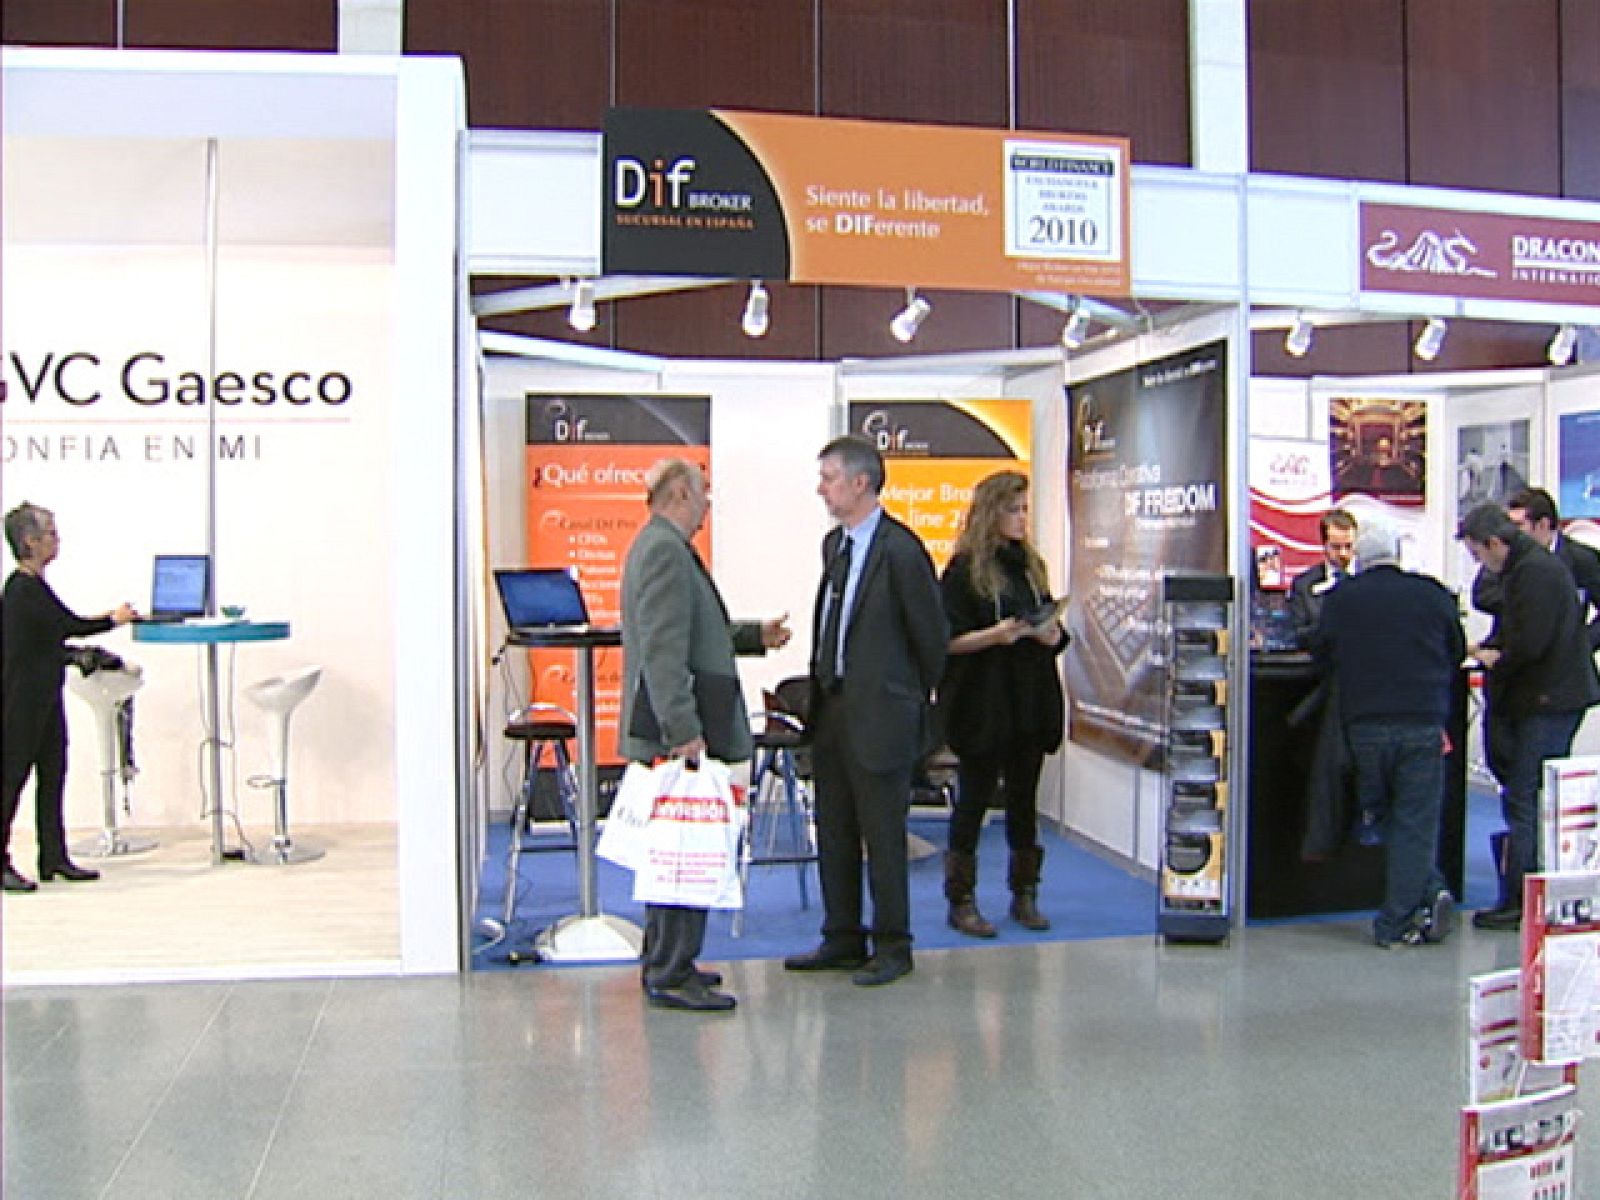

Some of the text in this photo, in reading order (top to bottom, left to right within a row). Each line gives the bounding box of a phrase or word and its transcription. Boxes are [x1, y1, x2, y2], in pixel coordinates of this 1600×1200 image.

[615, 158, 696, 208] Dif
[806, 184, 990, 217] Siente la libertad,
[806, 213, 941, 238] se DIFerente
[1029, 214, 1099, 246] 2010
[120, 351, 353, 406] Gaesco
[144, 434, 196, 461] EN
[218, 434, 262, 460] MI
